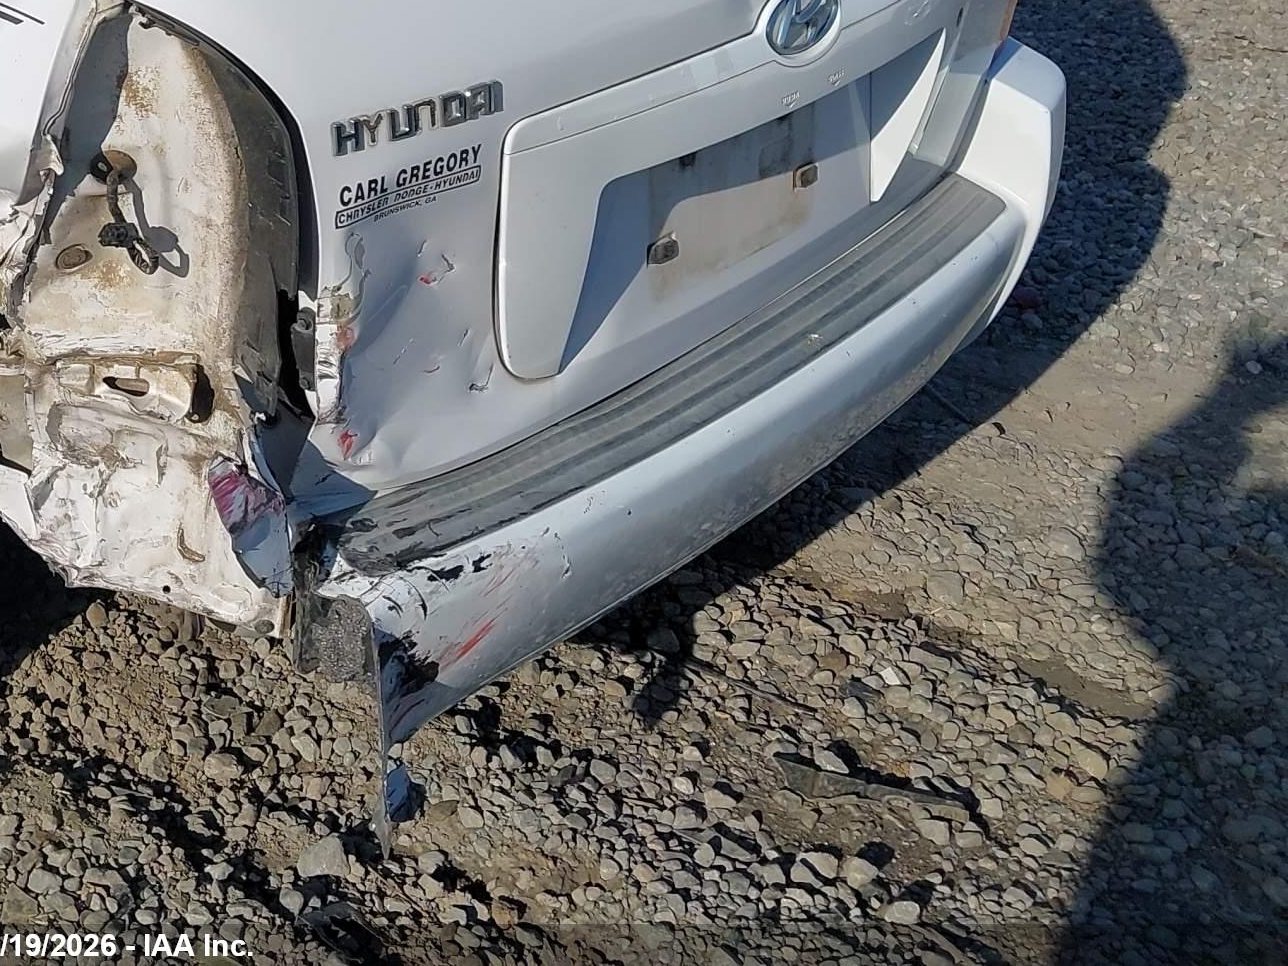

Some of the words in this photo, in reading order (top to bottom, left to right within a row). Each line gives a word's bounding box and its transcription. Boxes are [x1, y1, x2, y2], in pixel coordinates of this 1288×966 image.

[330, 80, 504, 157] HYUNDAI
[339, 175, 388, 207] CARL
[396, 144, 482, 188] GREGORY
[338, 196, 389, 224] CHRYSLER
[425, 196, 437, 204] GA
